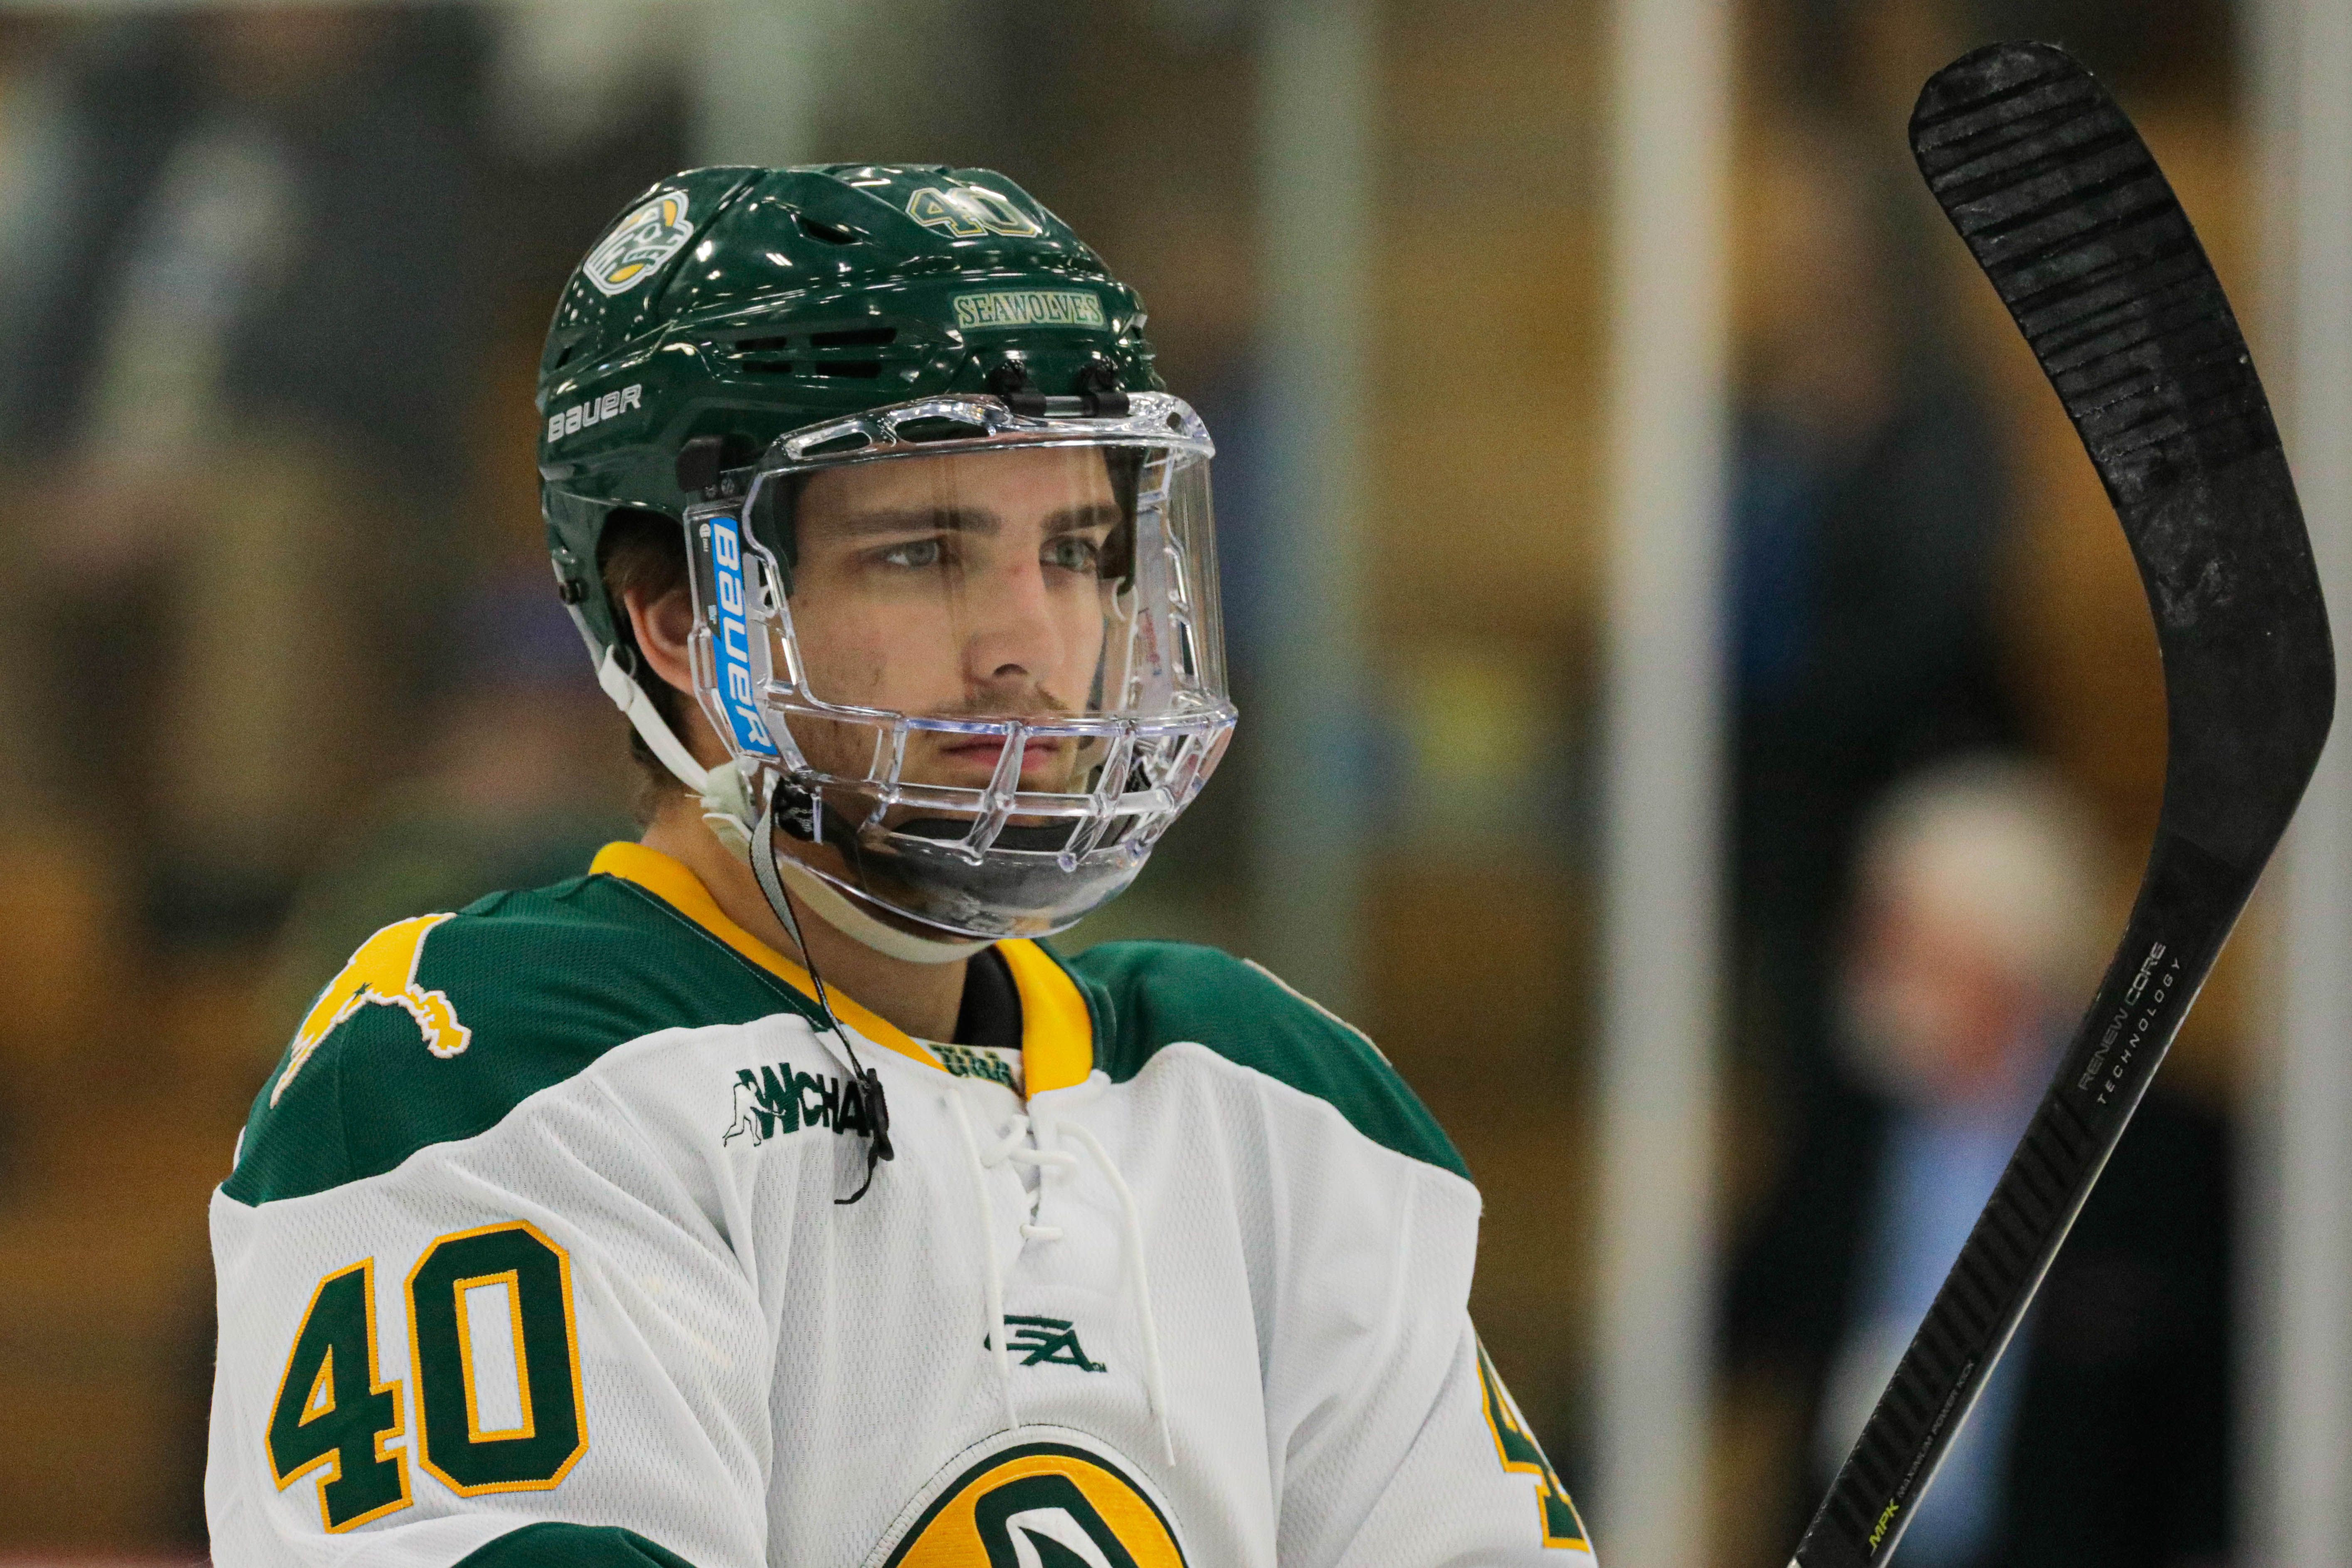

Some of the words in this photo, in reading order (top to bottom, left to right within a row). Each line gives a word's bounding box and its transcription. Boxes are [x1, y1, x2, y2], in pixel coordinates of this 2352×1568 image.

[906, 187, 1042, 238] 40
[954, 291, 1104, 329] SEAWOLVES
[2079, 1008, 2128, 1091] RENEW
[2125, 941, 2167, 1006] CORE
[2097, 958, 2181, 1105] TECHNOLOGY
[735, 1062, 871, 1139] WCHA
[264, 1219, 589, 1534] 40
[1869, 1499, 1899, 1549] MPK
